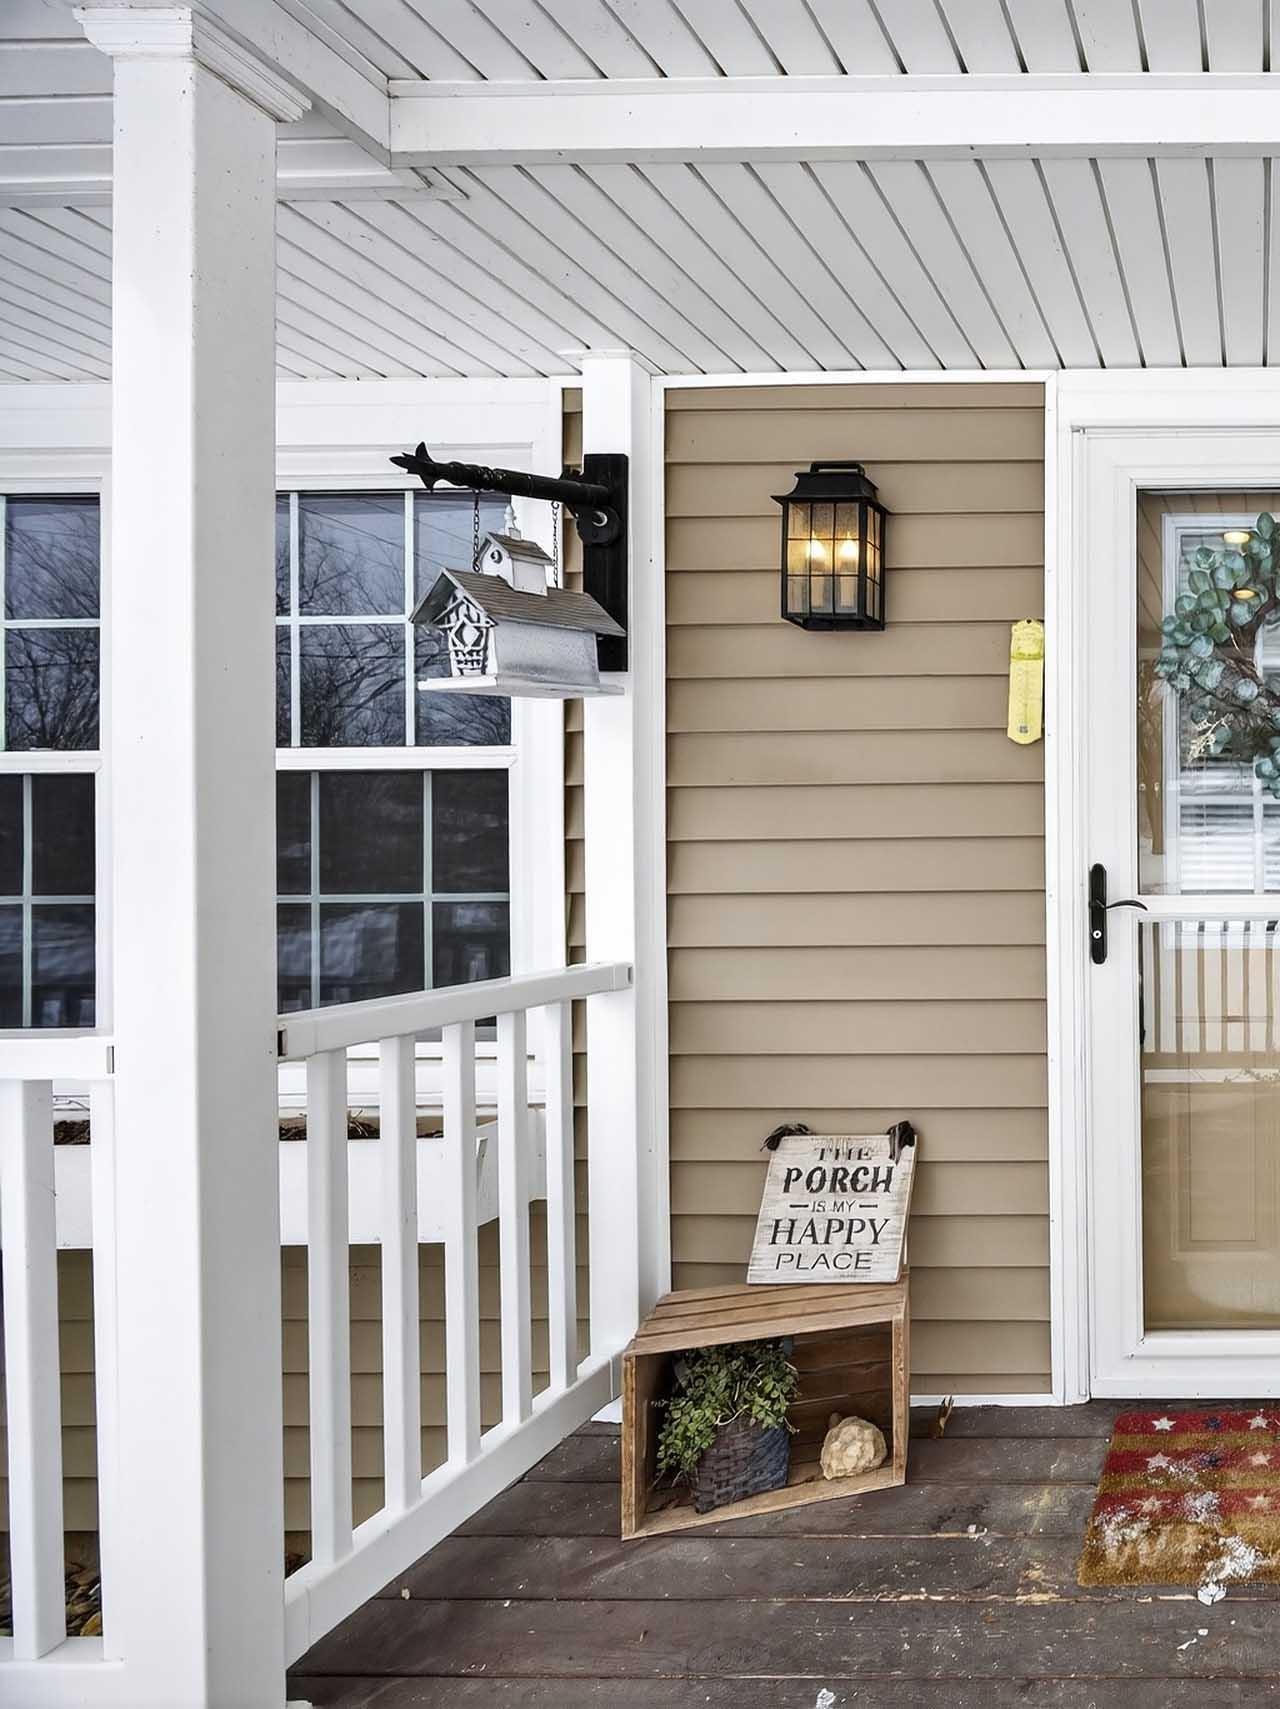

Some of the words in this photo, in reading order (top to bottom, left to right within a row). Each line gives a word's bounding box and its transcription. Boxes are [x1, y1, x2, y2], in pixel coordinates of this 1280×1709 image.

[814, 1147, 874, 1161] THE
[782, 1166, 893, 1193] PORCH
[811, 1200, 826, 1213] IS
[831, 1200, 857, 1213] MY
[768, 1218, 891, 1245] HAPPY
[775, 1252, 873, 1270] PLACE
